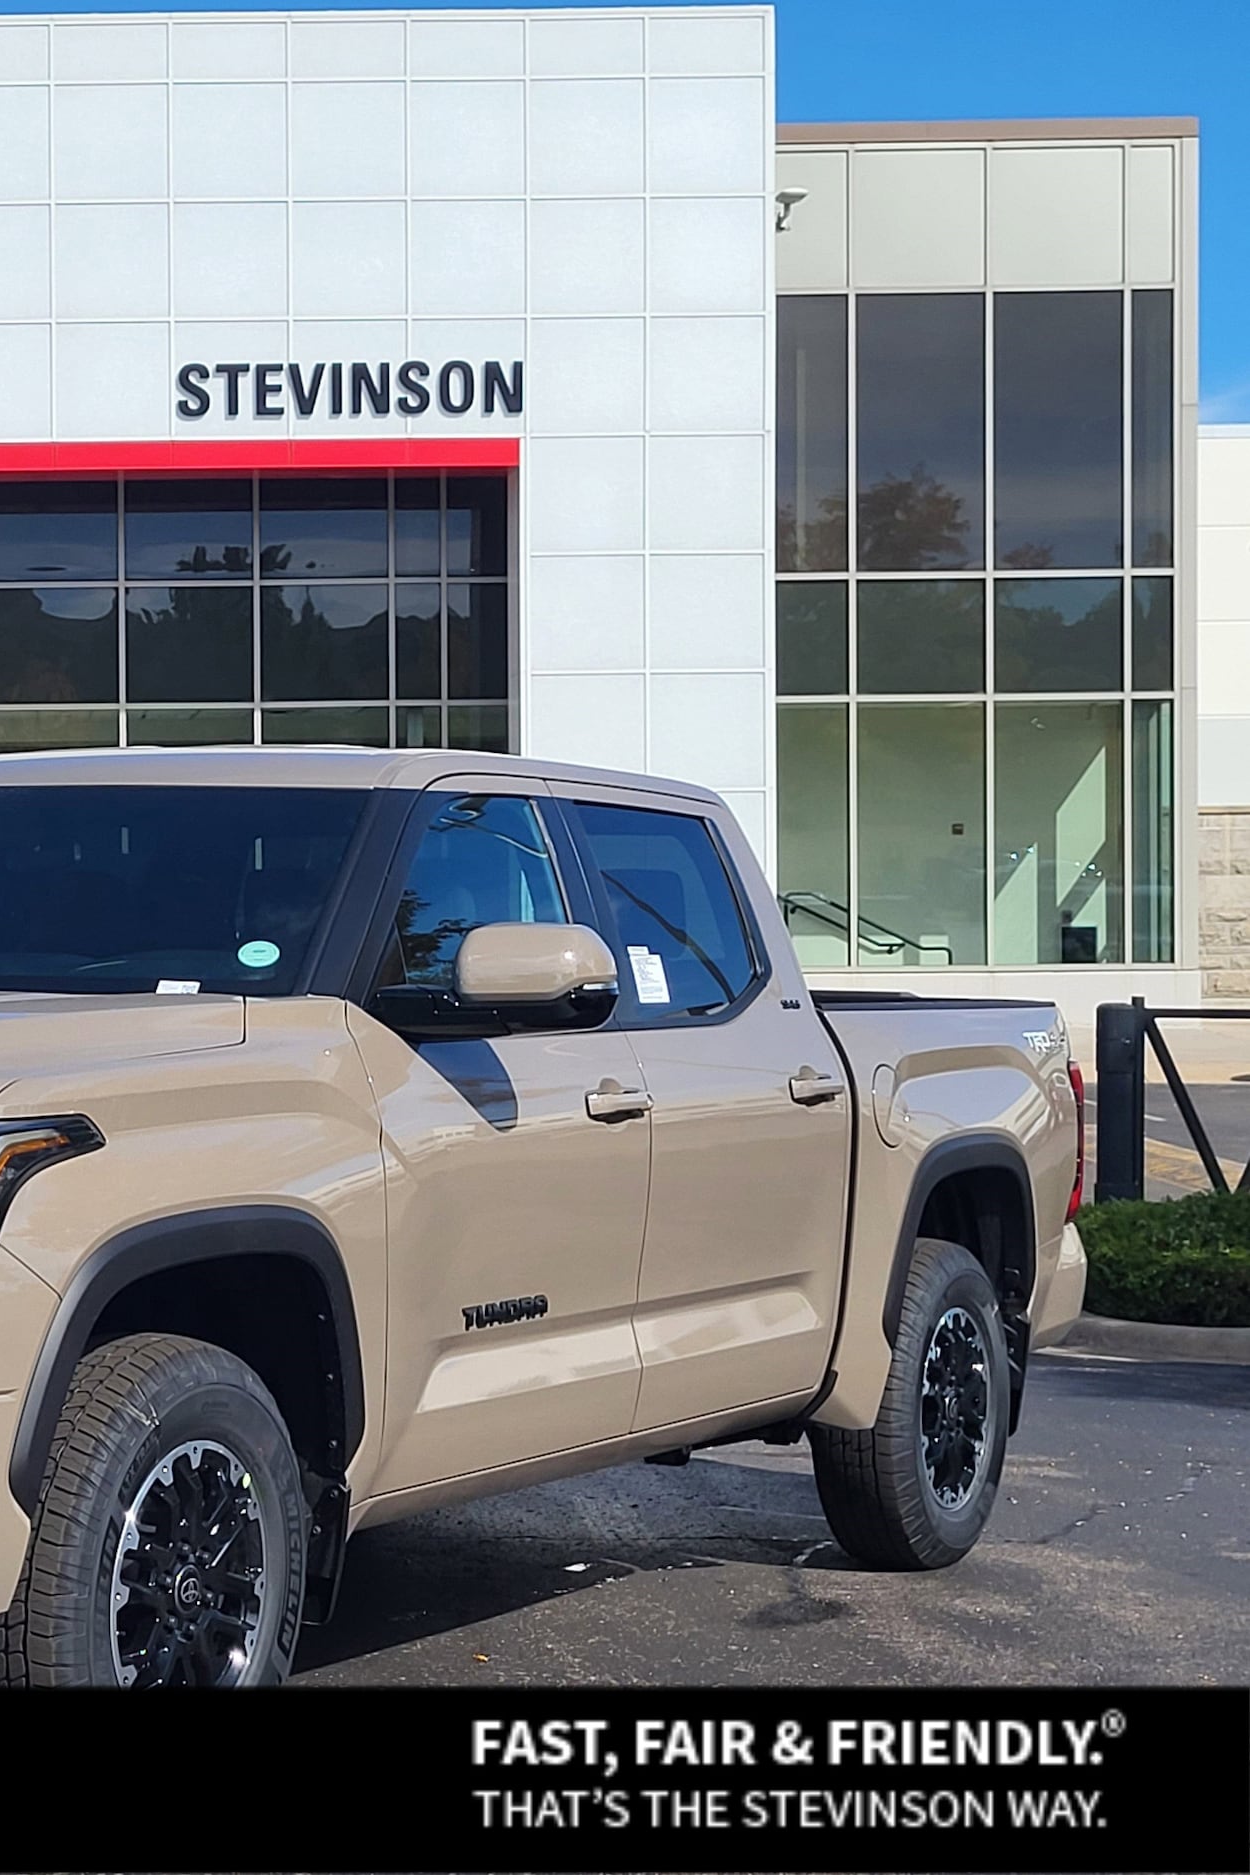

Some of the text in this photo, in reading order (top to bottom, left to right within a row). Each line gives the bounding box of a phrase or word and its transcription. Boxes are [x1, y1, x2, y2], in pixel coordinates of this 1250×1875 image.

[177, 360, 524, 417] STEVINSON
[1022, 1031, 1050, 1053] TRD
[461, 1294, 548, 1331] TUNDRA
